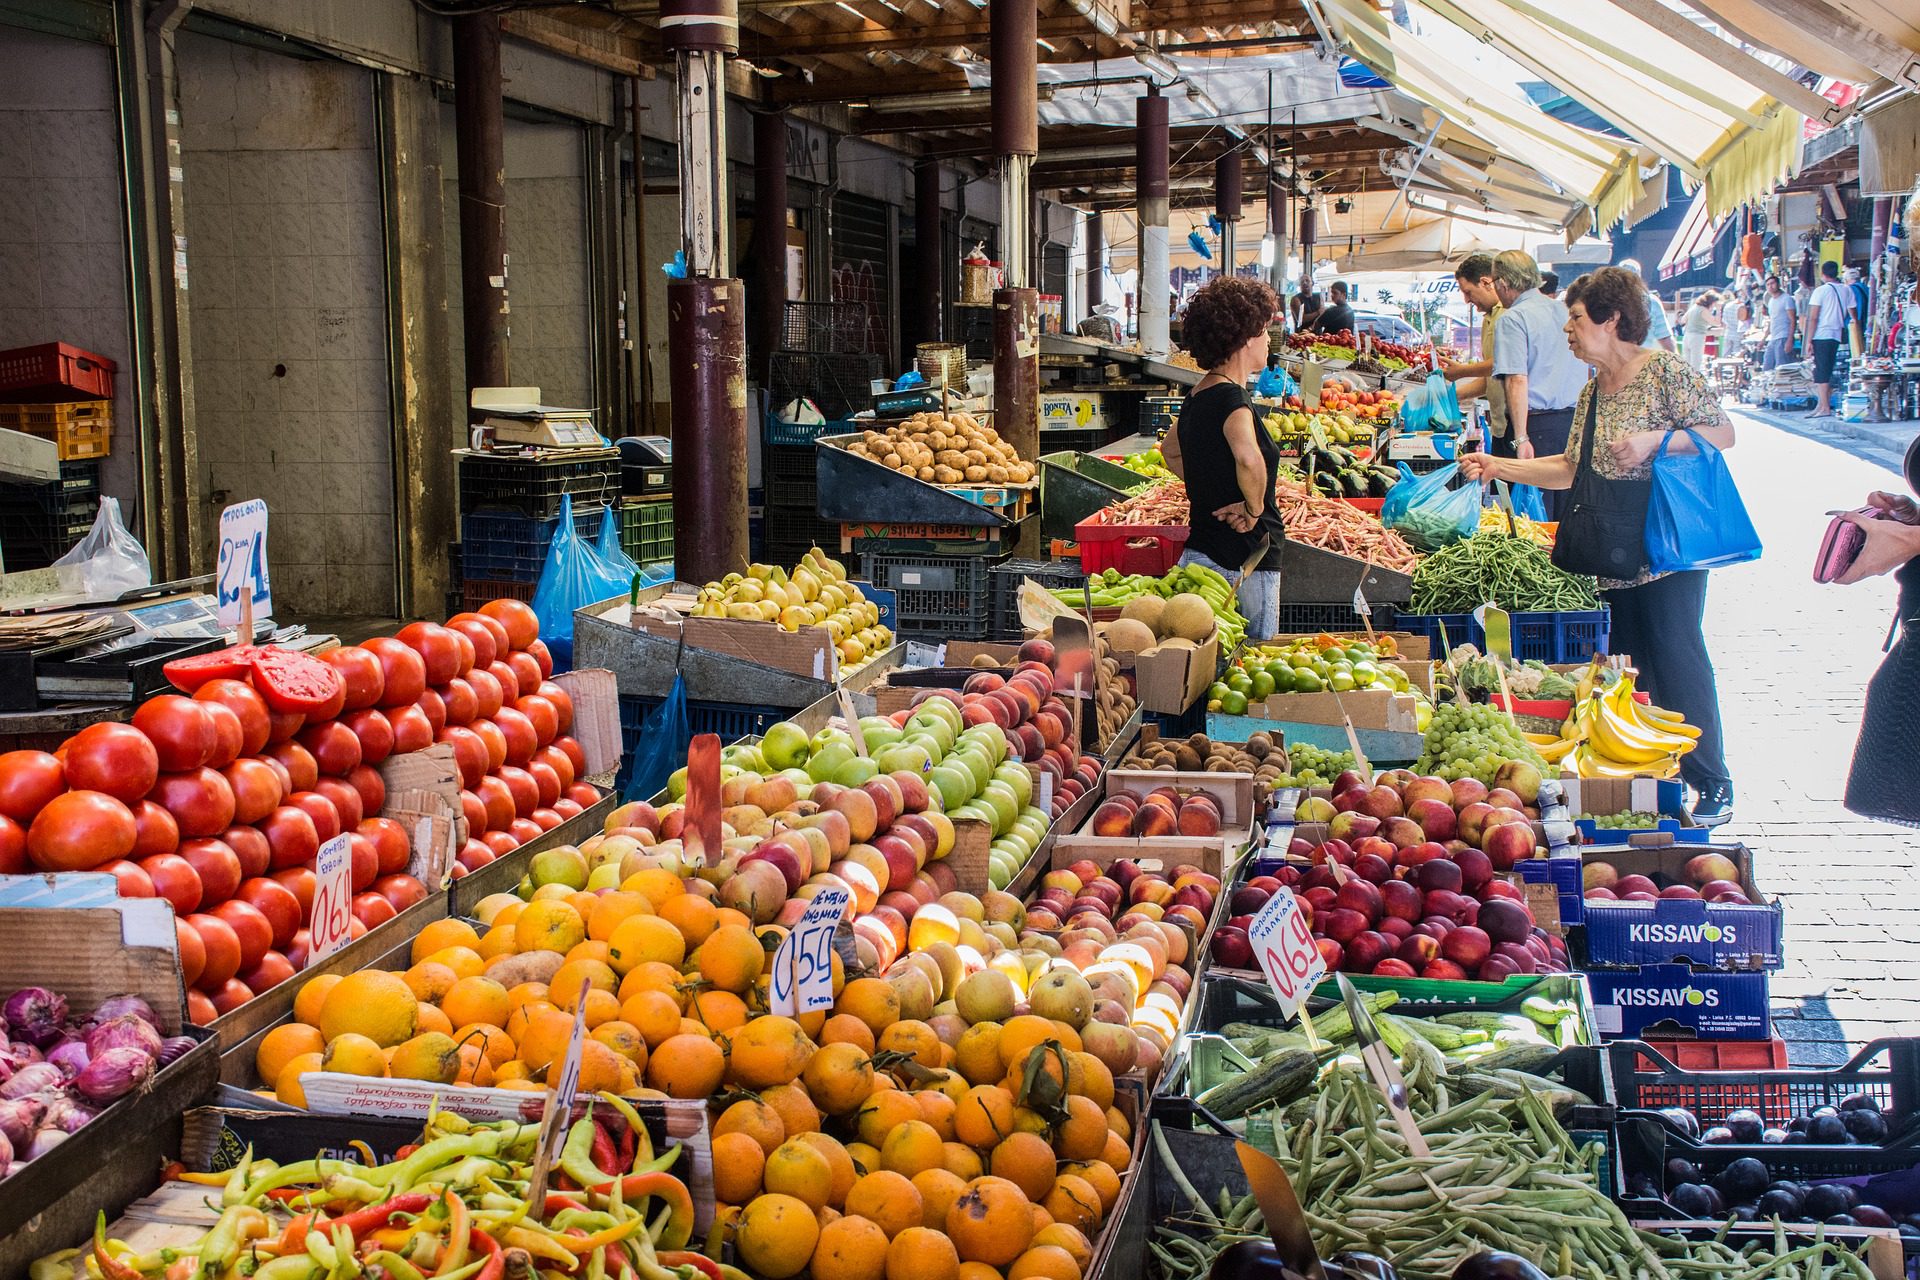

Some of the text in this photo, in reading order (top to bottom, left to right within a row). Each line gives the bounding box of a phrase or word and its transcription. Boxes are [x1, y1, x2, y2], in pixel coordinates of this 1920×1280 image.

[1044, 402, 1072, 416] BONITA
[890, 525, 966, 537] Fresh Fruits
[1629, 923, 1737, 944] KISSAVOS
[1612, 987, 1719, 1007] KISSAVOS
[470, 1095, 491, 1104] για
